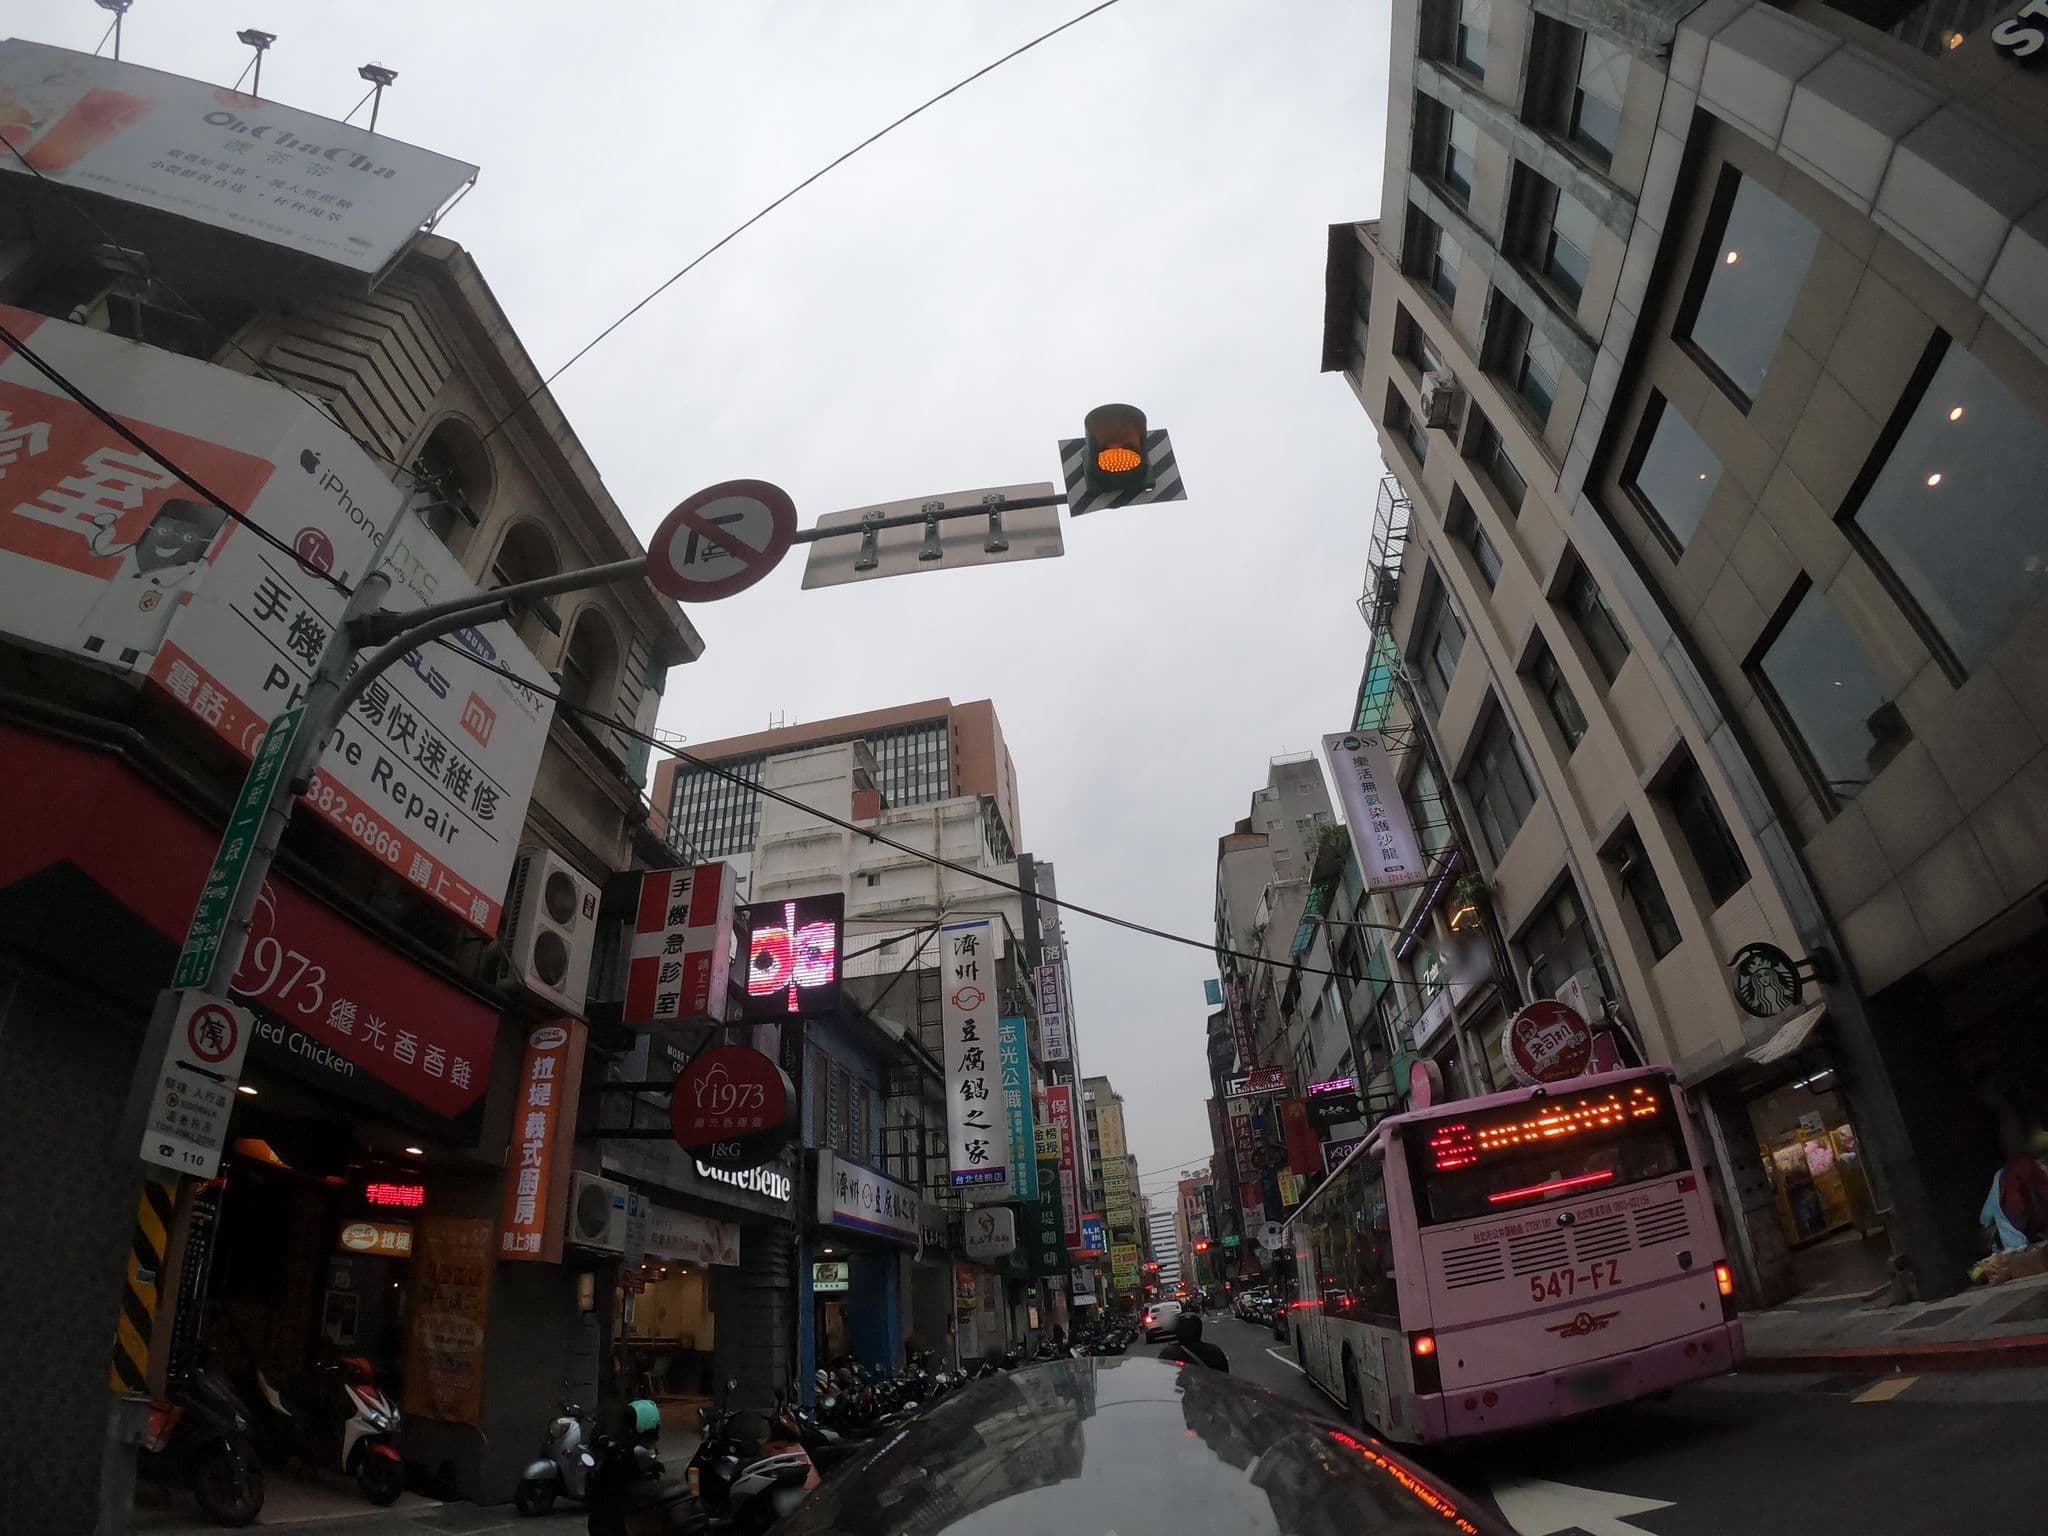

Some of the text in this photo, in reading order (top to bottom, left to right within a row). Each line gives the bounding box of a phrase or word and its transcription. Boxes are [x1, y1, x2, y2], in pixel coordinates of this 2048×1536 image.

[317, 469, 385, 548] iPhone
[401, 647, 452, 700] SUS
[371, 757, 460, 845] Repair
[407, 852, 492, 929] 請上二樓
[655, 877, 692, 1016] 手機急診室
[254, 1015, 355, 1077] ied Chicken
[326, 998, 475, 1091] 繼光香香雞
[998, 1024, 1024, 1110] 志光公職
[1044, 1016, 1063, 1059] 請上五樓
[710, 1084, 766, 1116] 1973
[957, 1018, 993, 1166] 豆腐鍋之家
[182, 1151, 205, 1167] 110
[710, 1142, 741, 1157] J&G
[1039, 1190, 1057, 1267] 丹堤咖啡
[1530, 1258, 1622, 1303] 547-FZ
